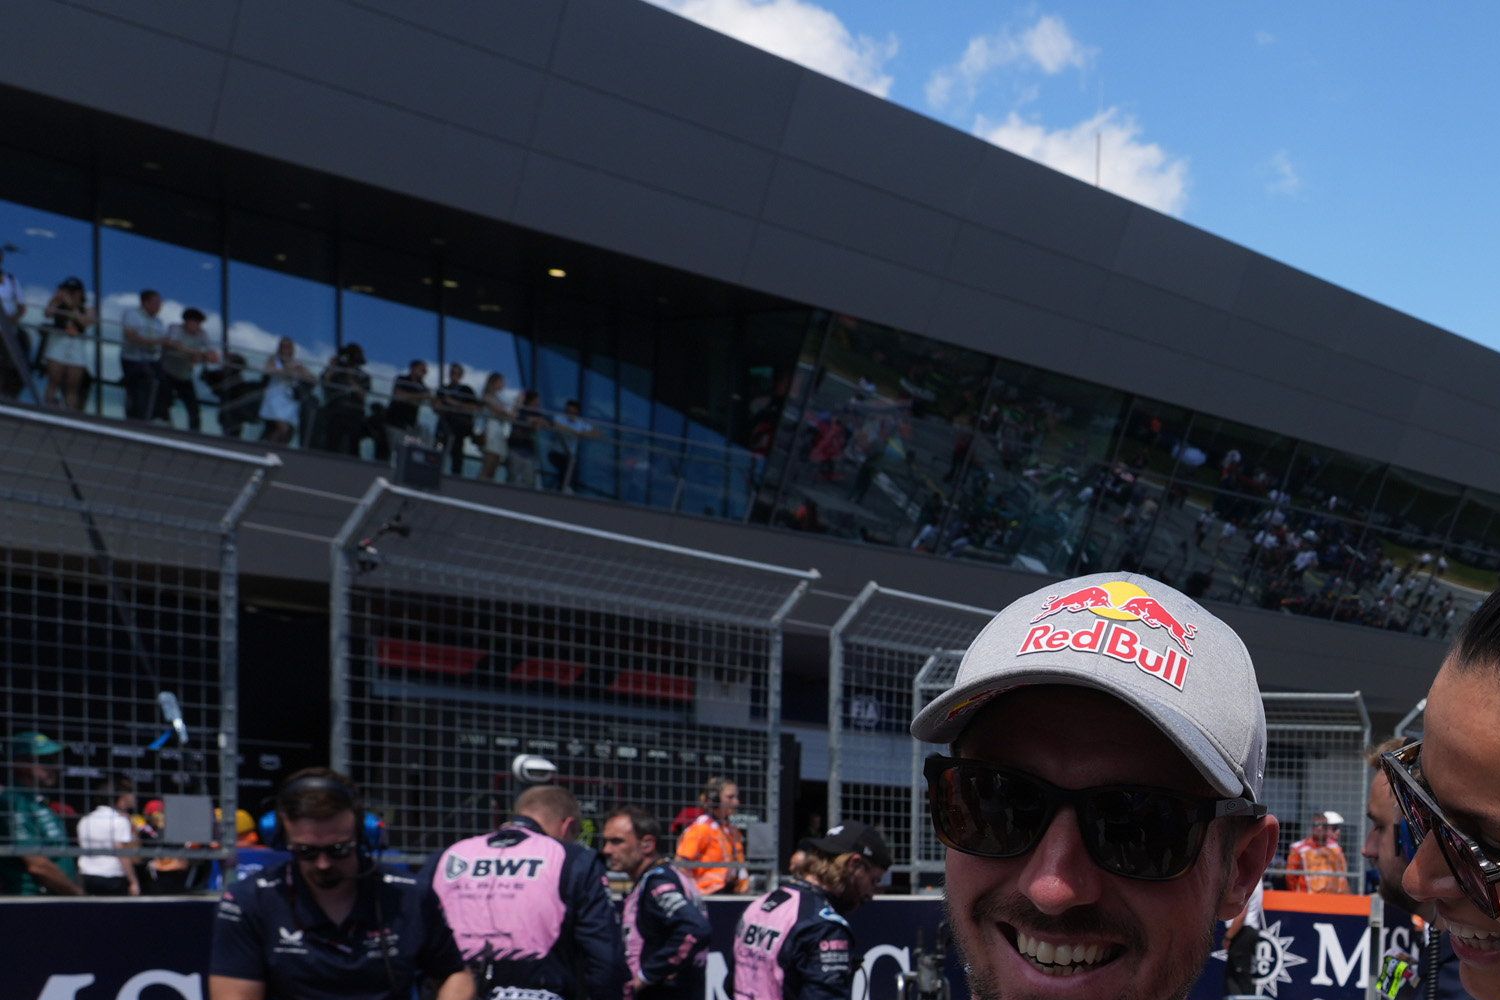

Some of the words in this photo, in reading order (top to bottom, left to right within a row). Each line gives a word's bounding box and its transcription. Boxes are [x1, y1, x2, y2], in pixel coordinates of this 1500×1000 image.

[1018, 620, 1106, 654] Red
[1104, 625, 1188, 689] Bull
[472, 859, 544, 877] BWT
